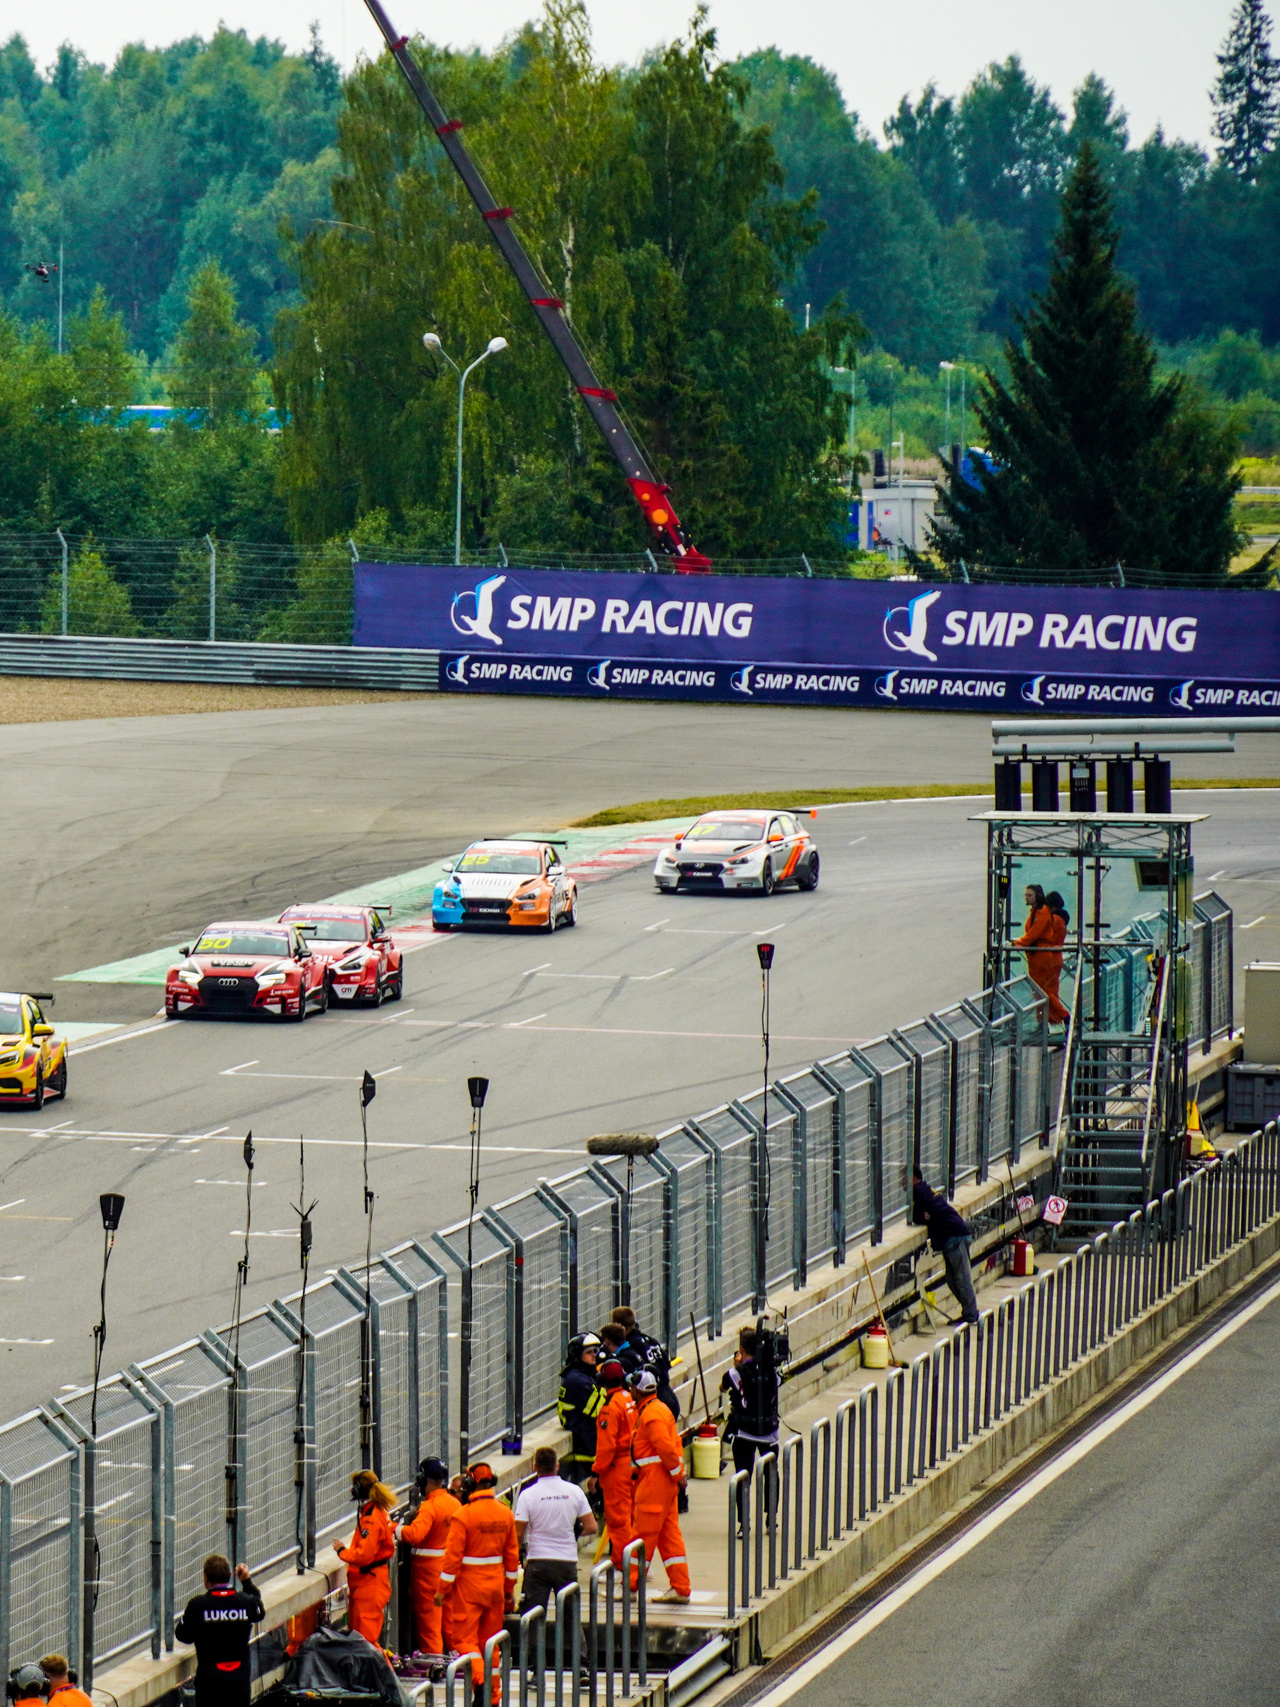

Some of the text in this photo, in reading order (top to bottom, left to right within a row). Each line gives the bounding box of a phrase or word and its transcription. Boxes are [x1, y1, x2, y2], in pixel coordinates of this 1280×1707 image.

[506, 594, 754, 638] SMP RACING
[942, 610, 1198, 652] SMP RACING
[469, 662, 573, 682] SMP RACING
[611, 667, 716, 687] SMP RACING
[755, 673, 860, 692] SMP RACING
[900, 677, 1006, 697] SMP RACING
[1046, 683, 1154, 702] SMP RACING
[1194, 688, 1234, 704] SMP
[461, 855, 491, 866] 25
[199, 938, 232, 950] 50
[204, 1609, 248, 1621] LUKOIL
